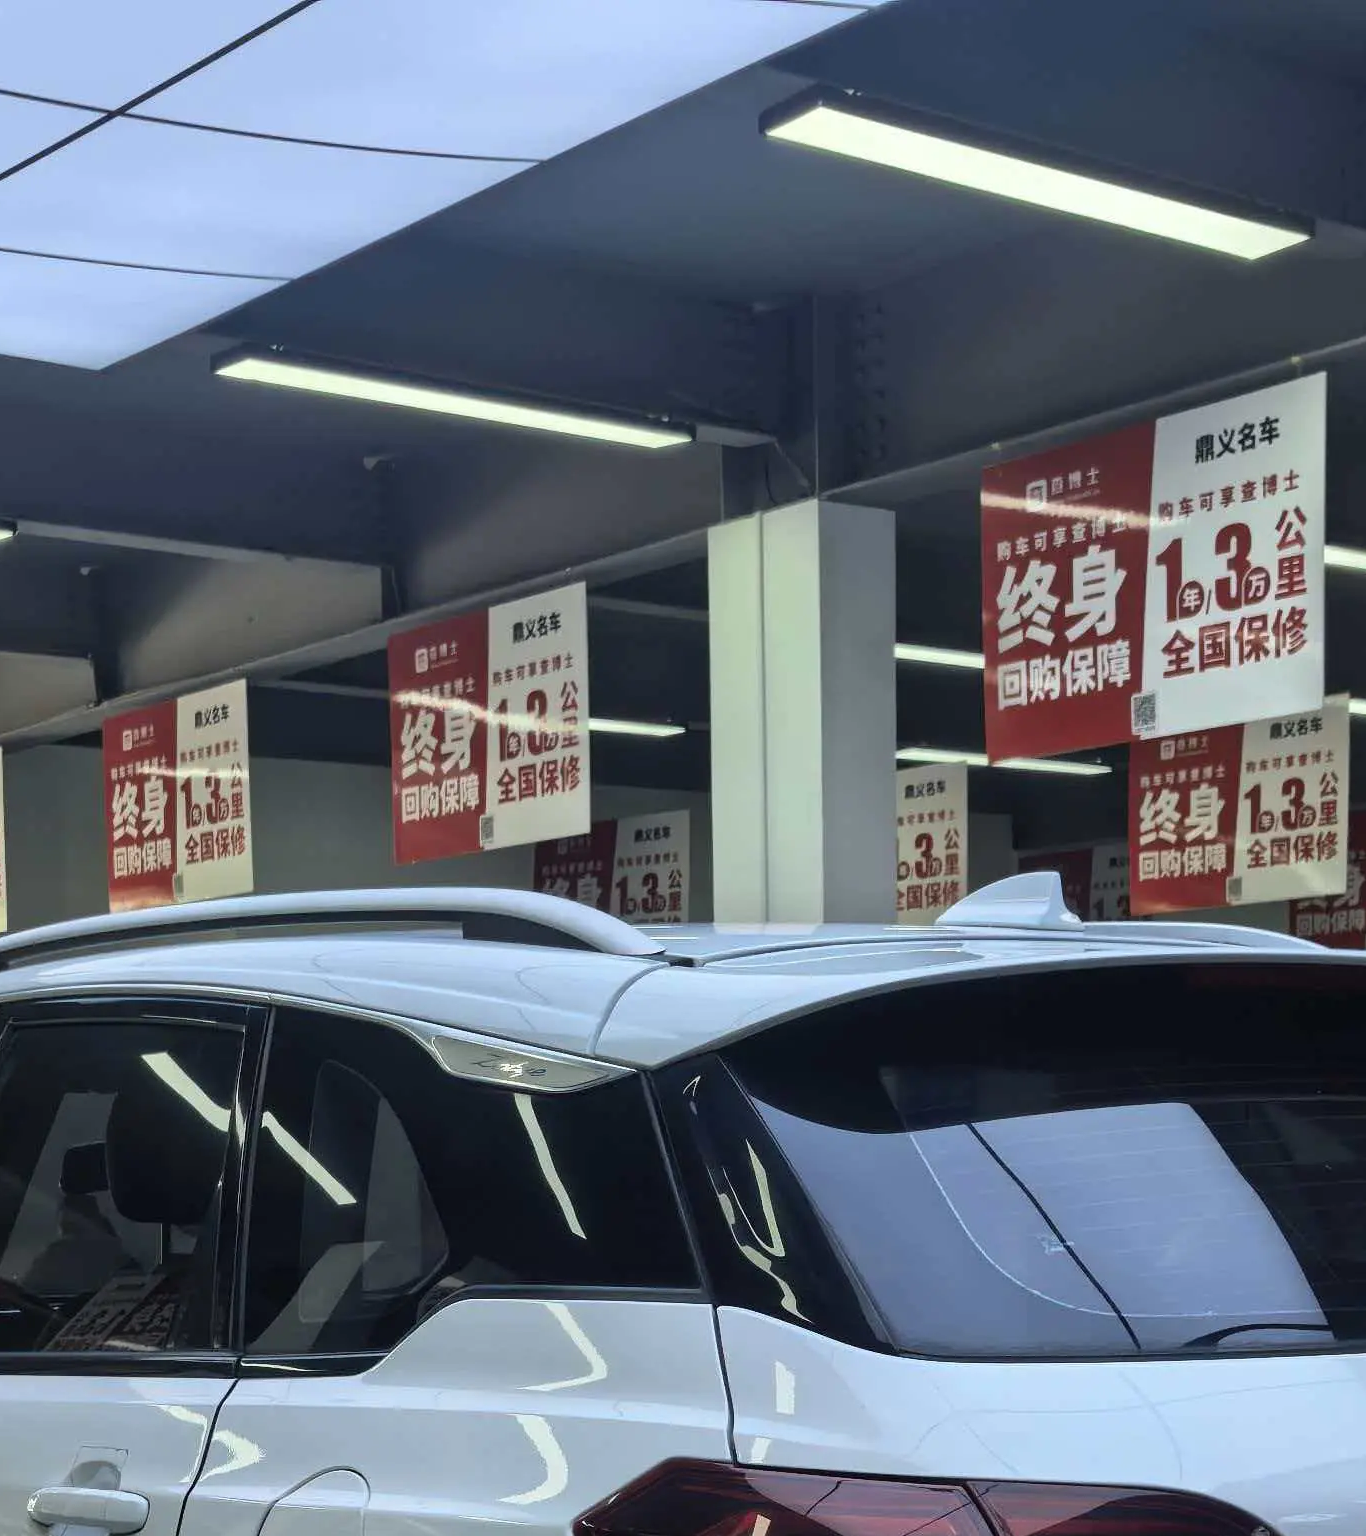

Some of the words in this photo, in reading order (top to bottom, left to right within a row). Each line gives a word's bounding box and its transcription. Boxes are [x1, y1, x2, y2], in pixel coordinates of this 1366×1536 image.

[1195, 417, 1280, 464] 鼎义名车
[1158, 469, 1300, 525] 购车可享查博士
[997, 512, 1131, 562] 购车可享查博士
[996, 545, 1127, 654] 终身
[512, 611, 561, 643] 鼎义名车
[1161, 606, 1309, 679] 全国保修
[997, 639, 1131, 710] 回购保障
[401, 708, 478, 779] 终身
[1270, 715, 1323, 740] 鼎义名车
[402, 774, 480, 823] 回购保障
[497, 756, 581, 805] 全国保修
[112, 776, 168, 841] 终身
[1139, 784, 1226, 845] 终身
[113, 837, 172, 879] 回购保障
[185, 824, 246, 866] 全国保修
[1139, 843, 1227, 882] 回购保障
[1246, 829, 1339, 869] 全国保修
